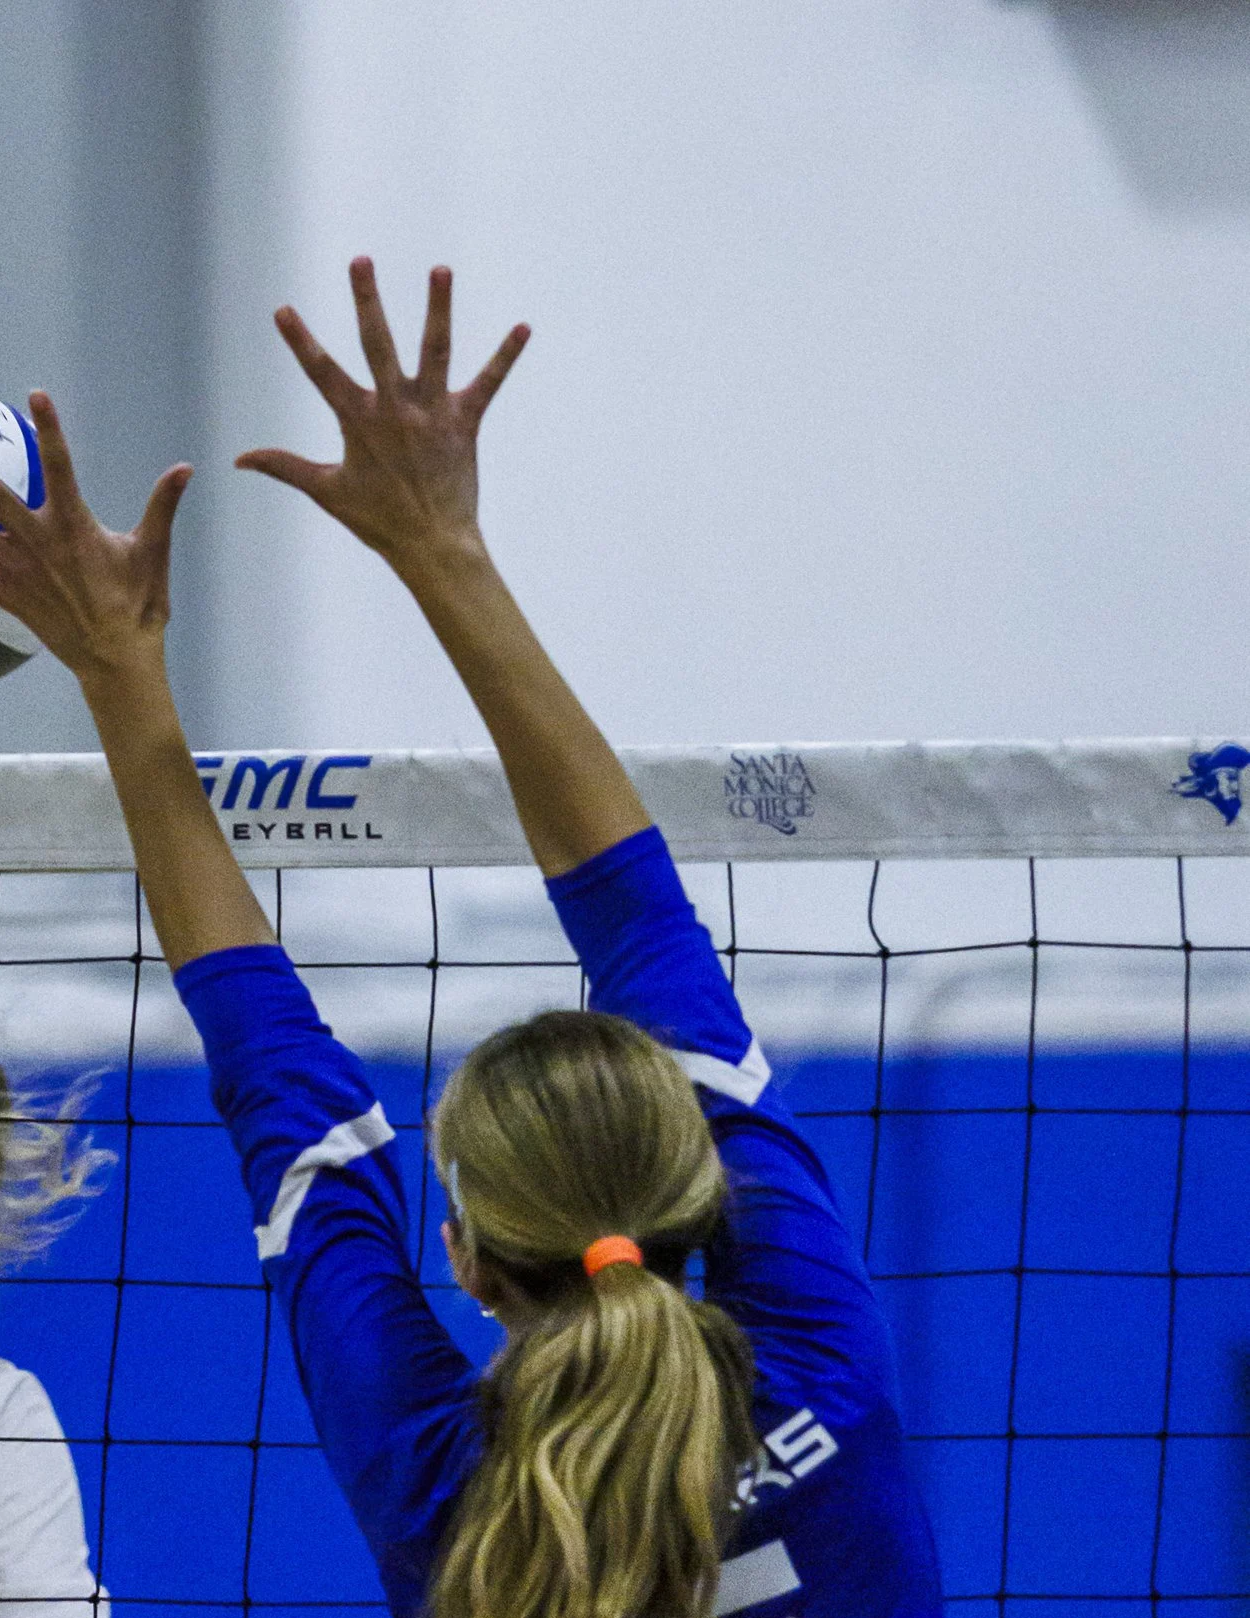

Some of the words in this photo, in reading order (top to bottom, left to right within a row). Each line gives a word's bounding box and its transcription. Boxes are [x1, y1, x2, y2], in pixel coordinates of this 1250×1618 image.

[729, 753, 807, 775] SANTA
[724, 775, 816, 797] MONICA
[729, 797, 815, 835] COLLEGE
[233, 822, 383, 840] EYBALL
